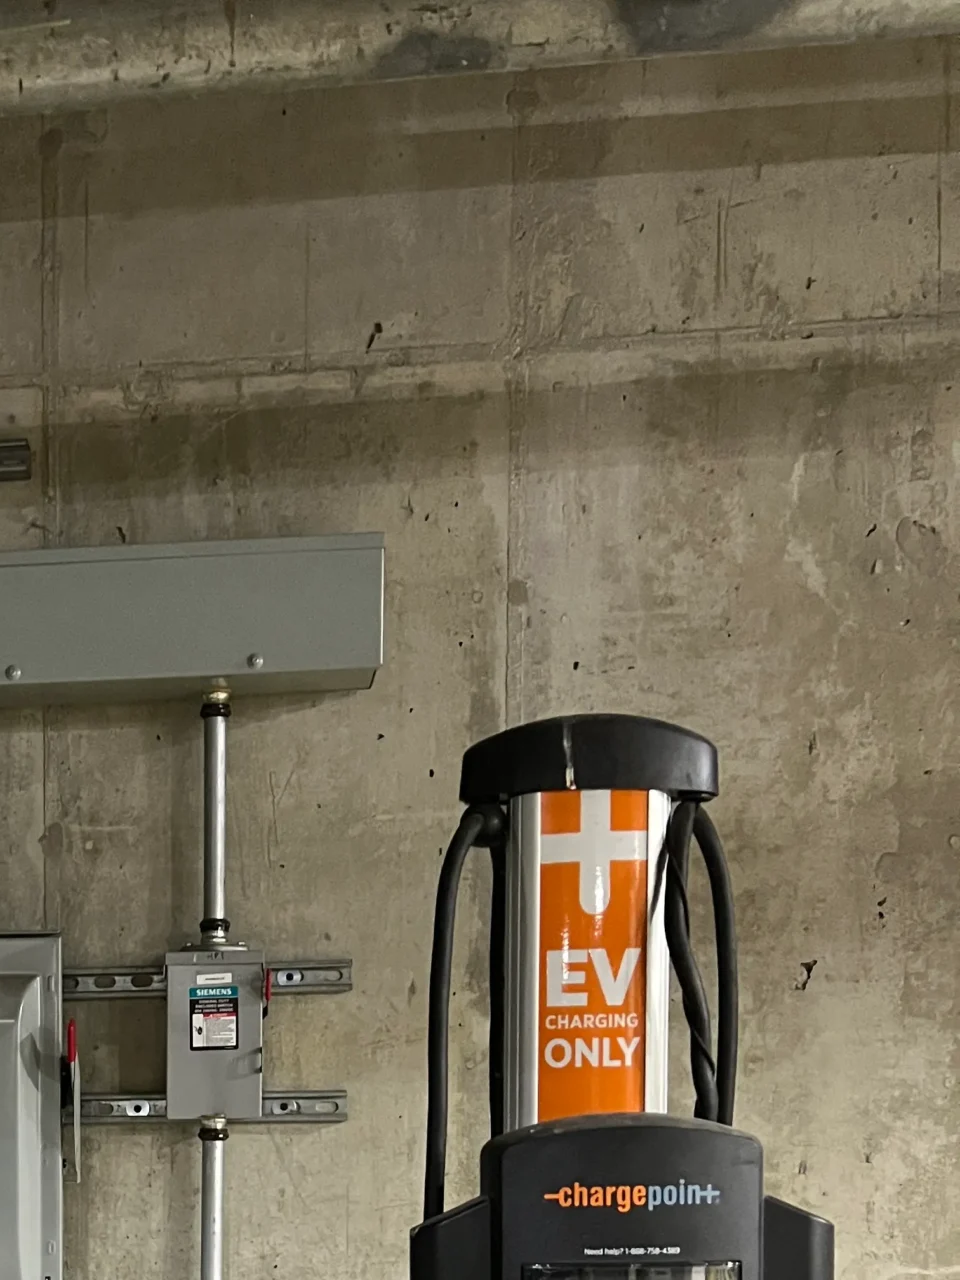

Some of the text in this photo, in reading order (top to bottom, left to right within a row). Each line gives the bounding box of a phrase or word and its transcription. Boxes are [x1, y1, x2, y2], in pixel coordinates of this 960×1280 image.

[546, 948, 641, 1007] EV
[196, 988, 232, 996] SIEMENS
[545, 1013, 638, 1029] CHARGING
[544, 1037, 640, 1068] ONLY
[584, 1248, 604, 1256] Need
[604, 1247, 624, 1257] help?
